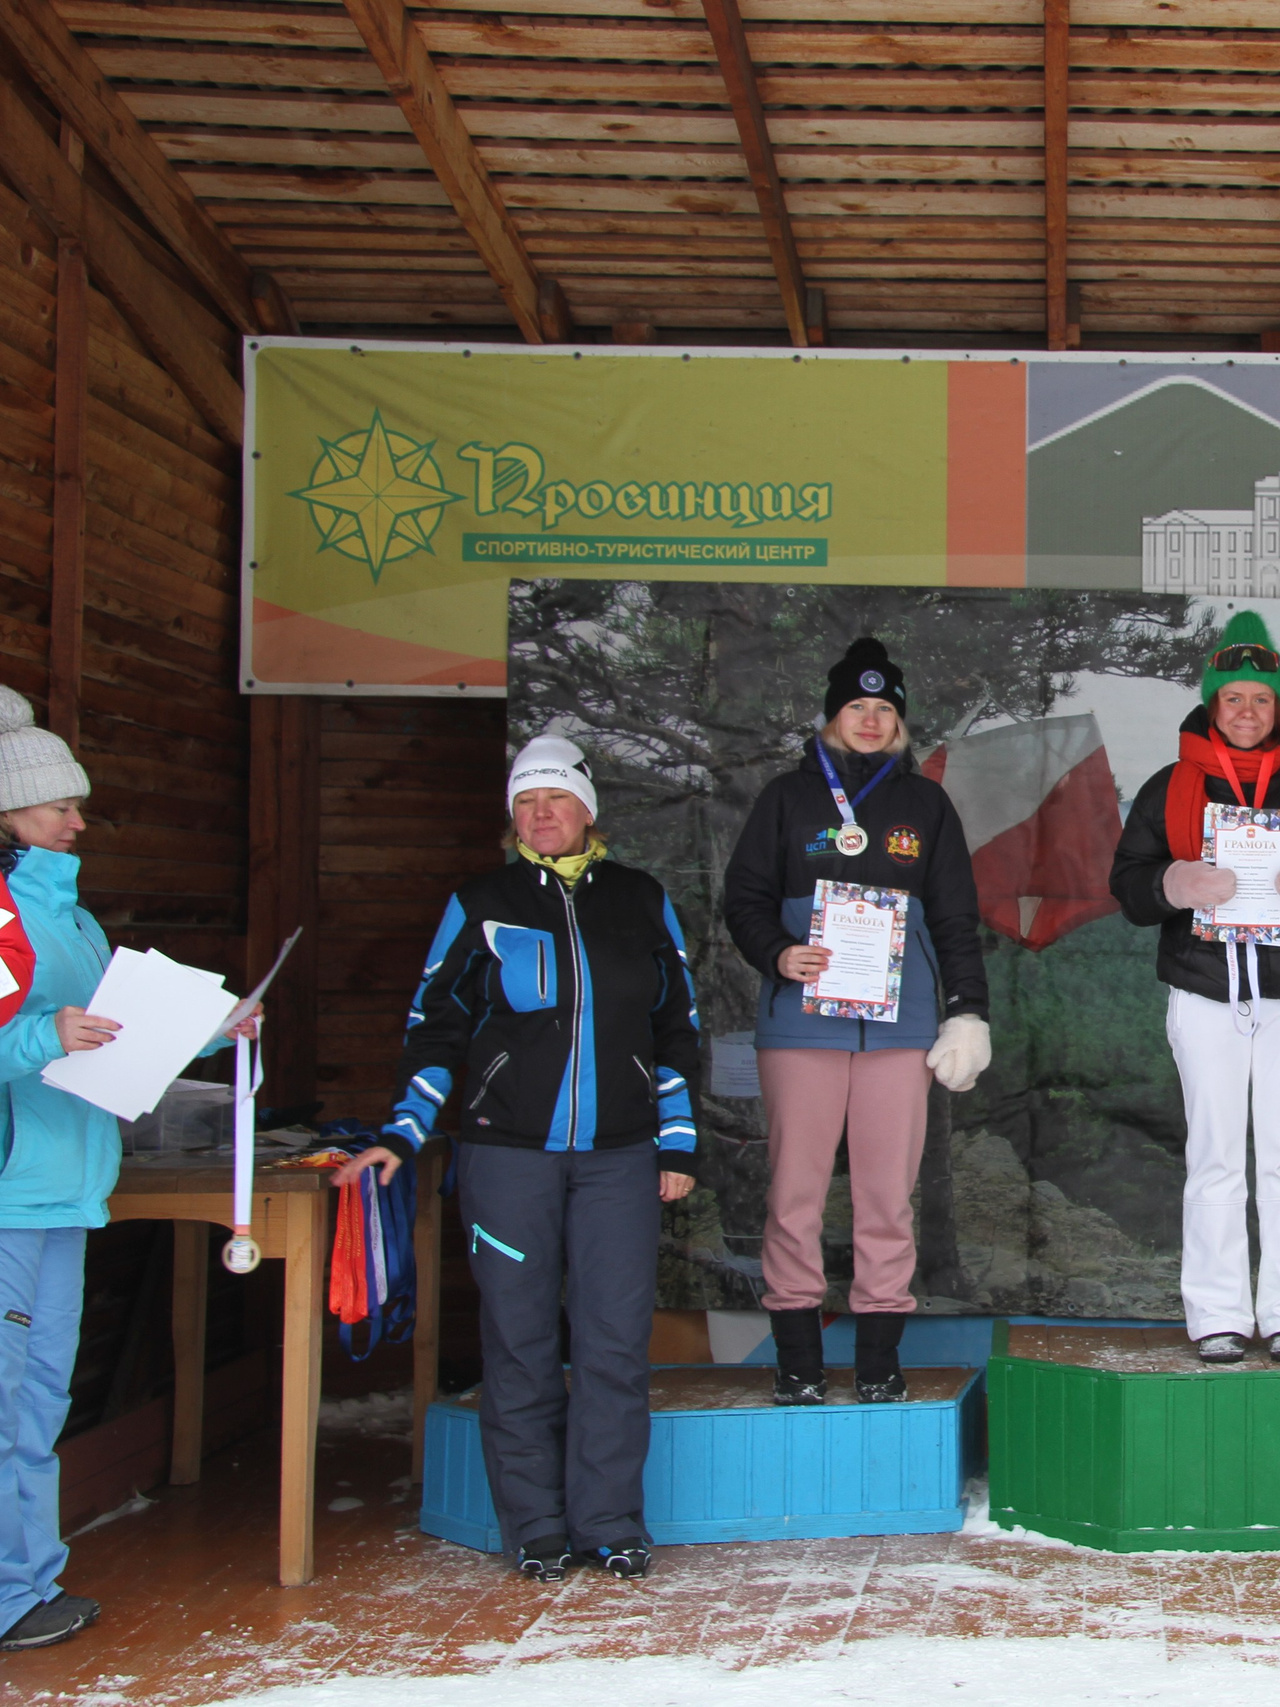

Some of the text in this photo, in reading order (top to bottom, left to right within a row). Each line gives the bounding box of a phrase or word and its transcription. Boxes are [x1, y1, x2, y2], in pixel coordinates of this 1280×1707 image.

[457, 441, 832, 532] Провинция
[475, 541, 816, 562] СПОРТИВНО-ТУРИСТИЧЕСКИЙ ЦЕНТР
[1224, 840, 1277, 850] ГРАМОТА
[832, 913, 885, 928] ГРАМОТА
